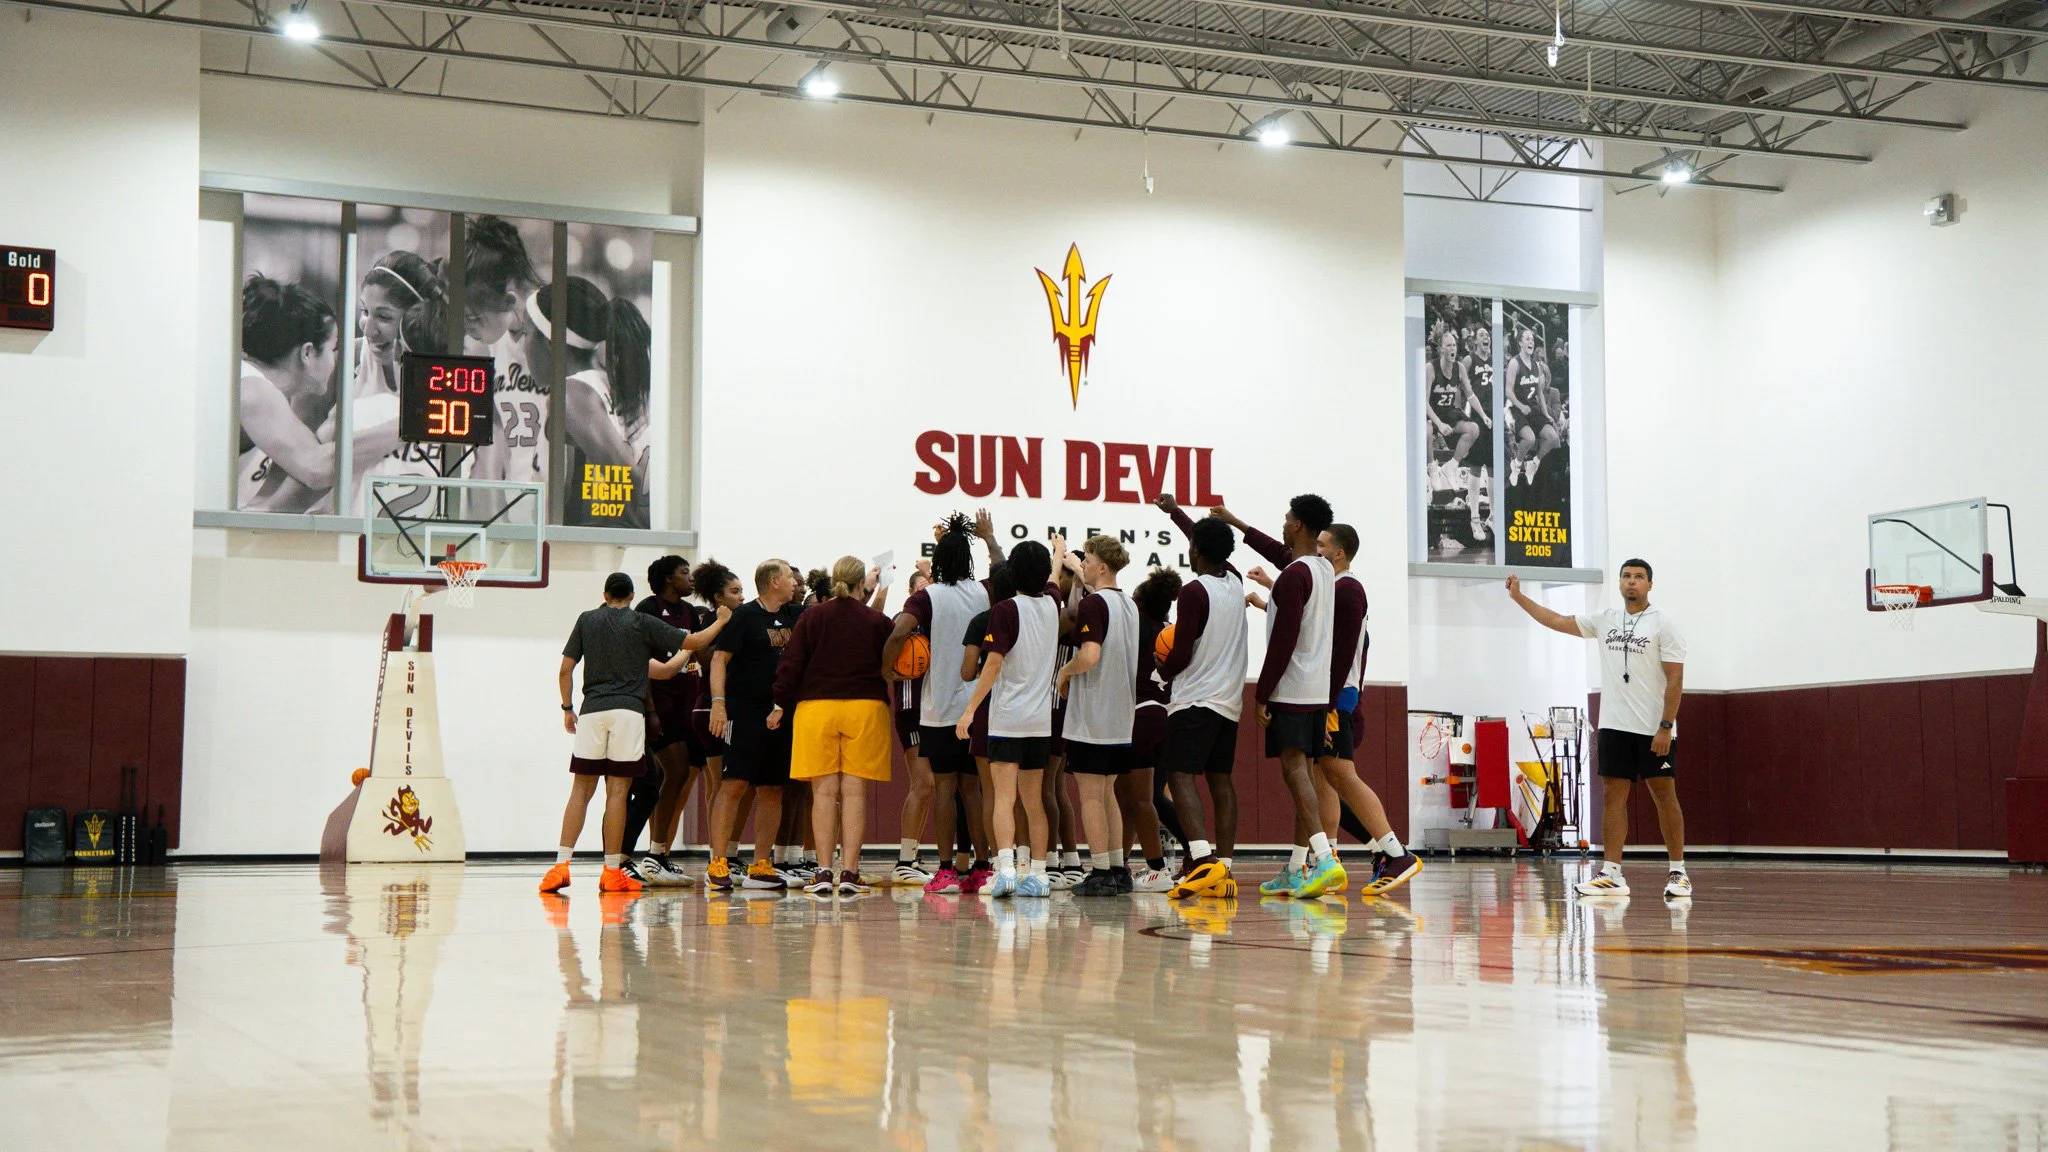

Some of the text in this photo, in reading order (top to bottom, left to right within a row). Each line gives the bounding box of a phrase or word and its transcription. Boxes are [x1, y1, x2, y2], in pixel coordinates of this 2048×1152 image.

[8, 251, 41, 269] Gold
[29, 273, 50, 306] 0
[429, 366, 486, 393] 2:00
[428, 399, 470, 436] 30
[500, 402, 541, 447] 23
[584, 464, 632, 483] ELITE
[913, 430, 1226, 507] SUN DEVIL
[581, 482, 634, 501] EIGHT
[591, 503, 625, 517] 2007
[1513, 510, 1561, 527] SWEET
[1010, 524, 1172, 546] OMEN'S
[1508, 526, 1567, 544] SIXTEEN
[1525, 544, 1552, 557] 2005
[1608, 645, 1644, 654] BASKBALL
[405, 707, 413, 776] DEVILS
[74, 848, 116, 857] BASKETBALL
